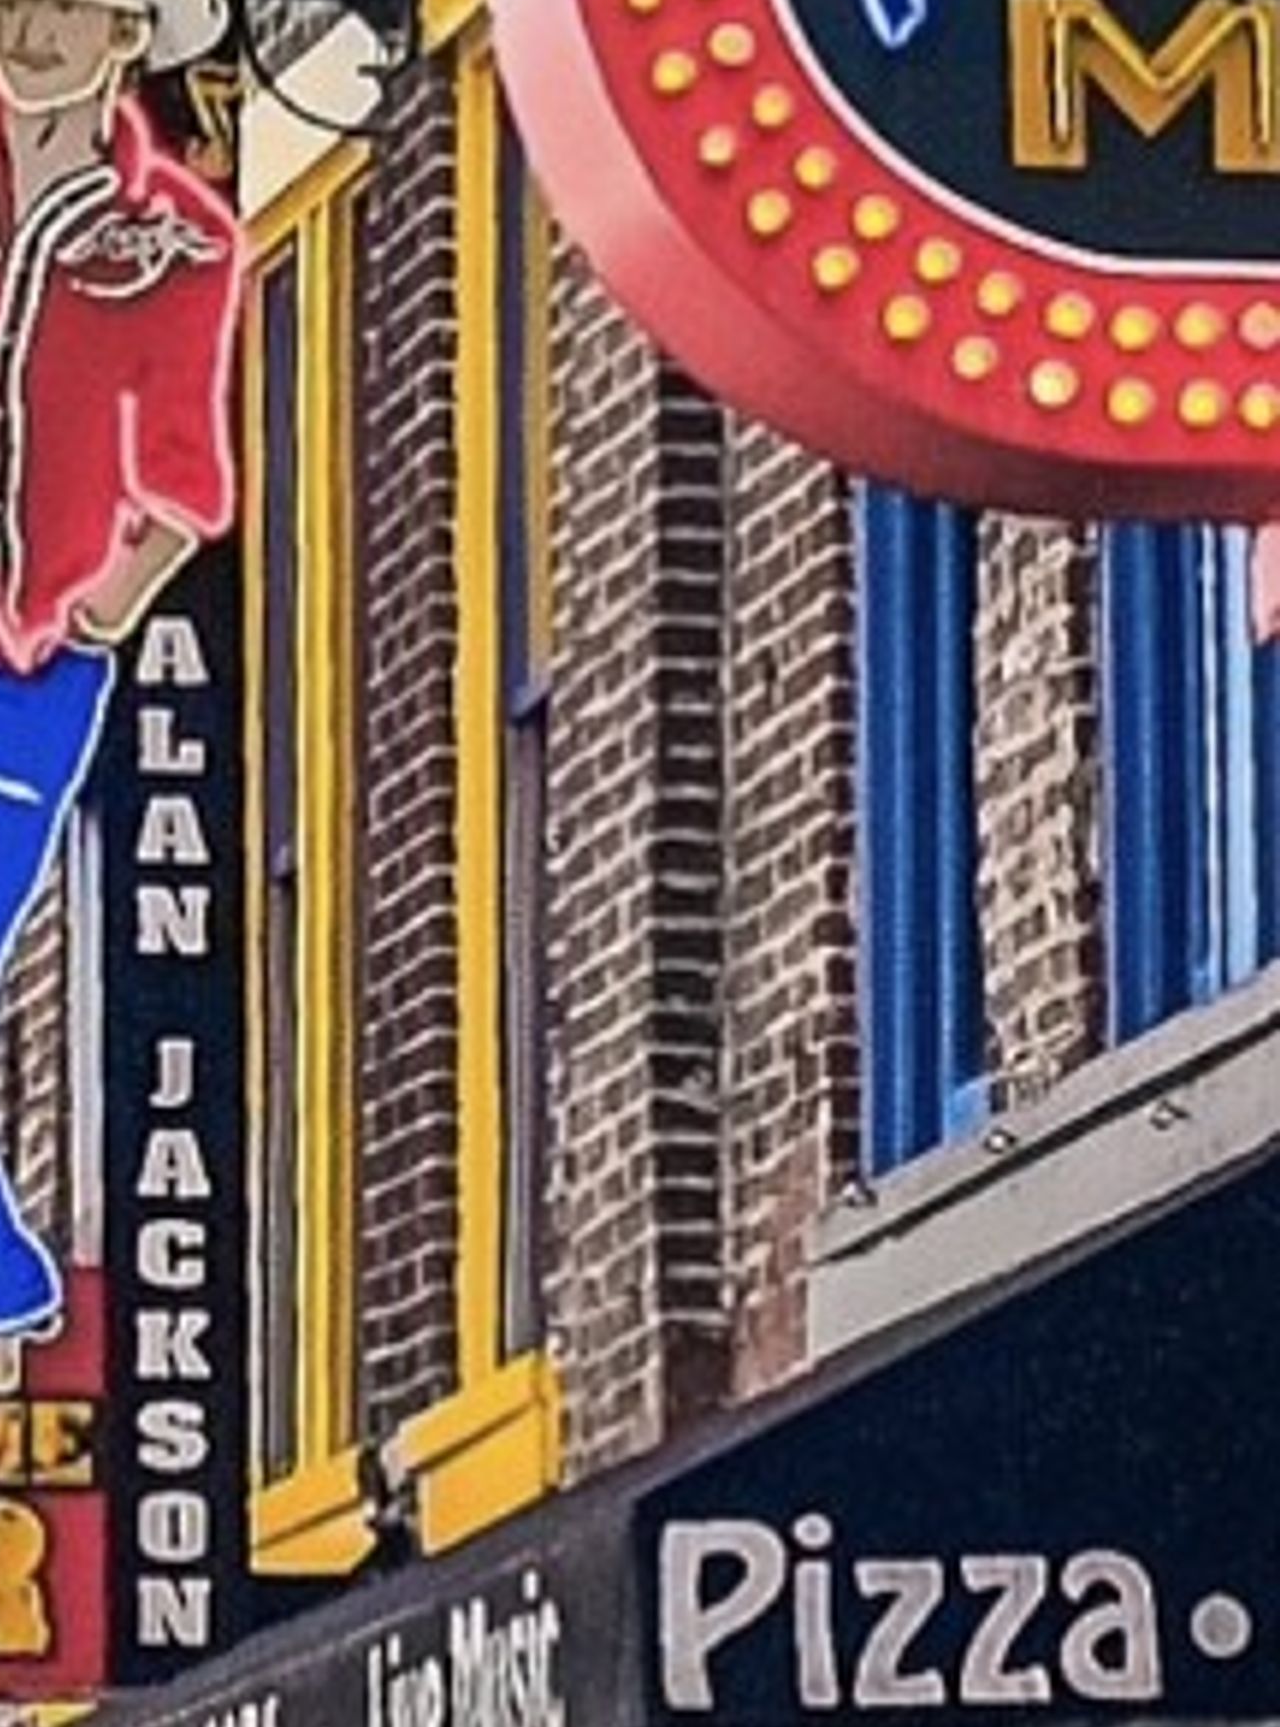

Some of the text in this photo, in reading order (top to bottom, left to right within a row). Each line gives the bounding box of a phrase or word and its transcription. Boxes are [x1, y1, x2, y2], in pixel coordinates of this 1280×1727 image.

[136, 614, 211, 1647] ALAN JACKSON
[658, 1512, 1162, 1709] Pizza
